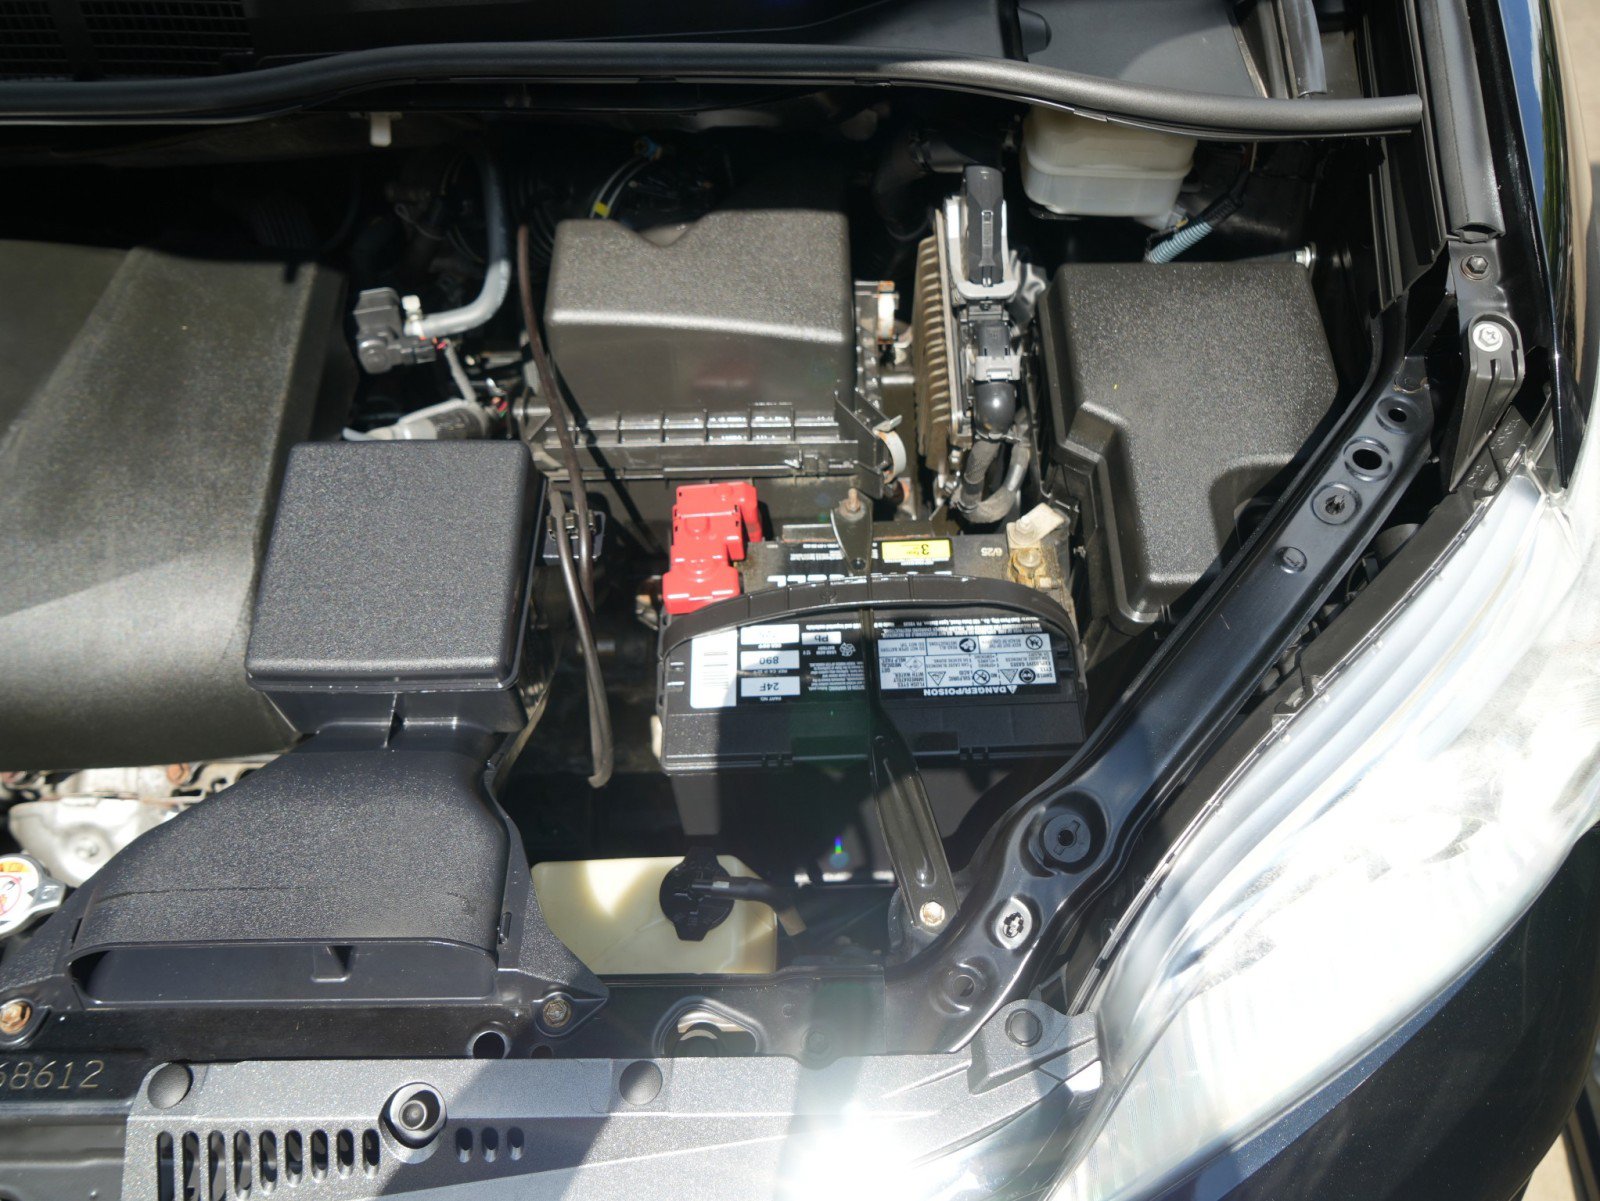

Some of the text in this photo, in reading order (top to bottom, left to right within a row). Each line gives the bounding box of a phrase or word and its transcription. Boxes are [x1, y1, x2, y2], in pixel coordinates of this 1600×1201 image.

[921, 544, 930, 556] 3
[759, 682, 780, 692] 24F
[924, 686, 1007, 696] DANGER/POISON
